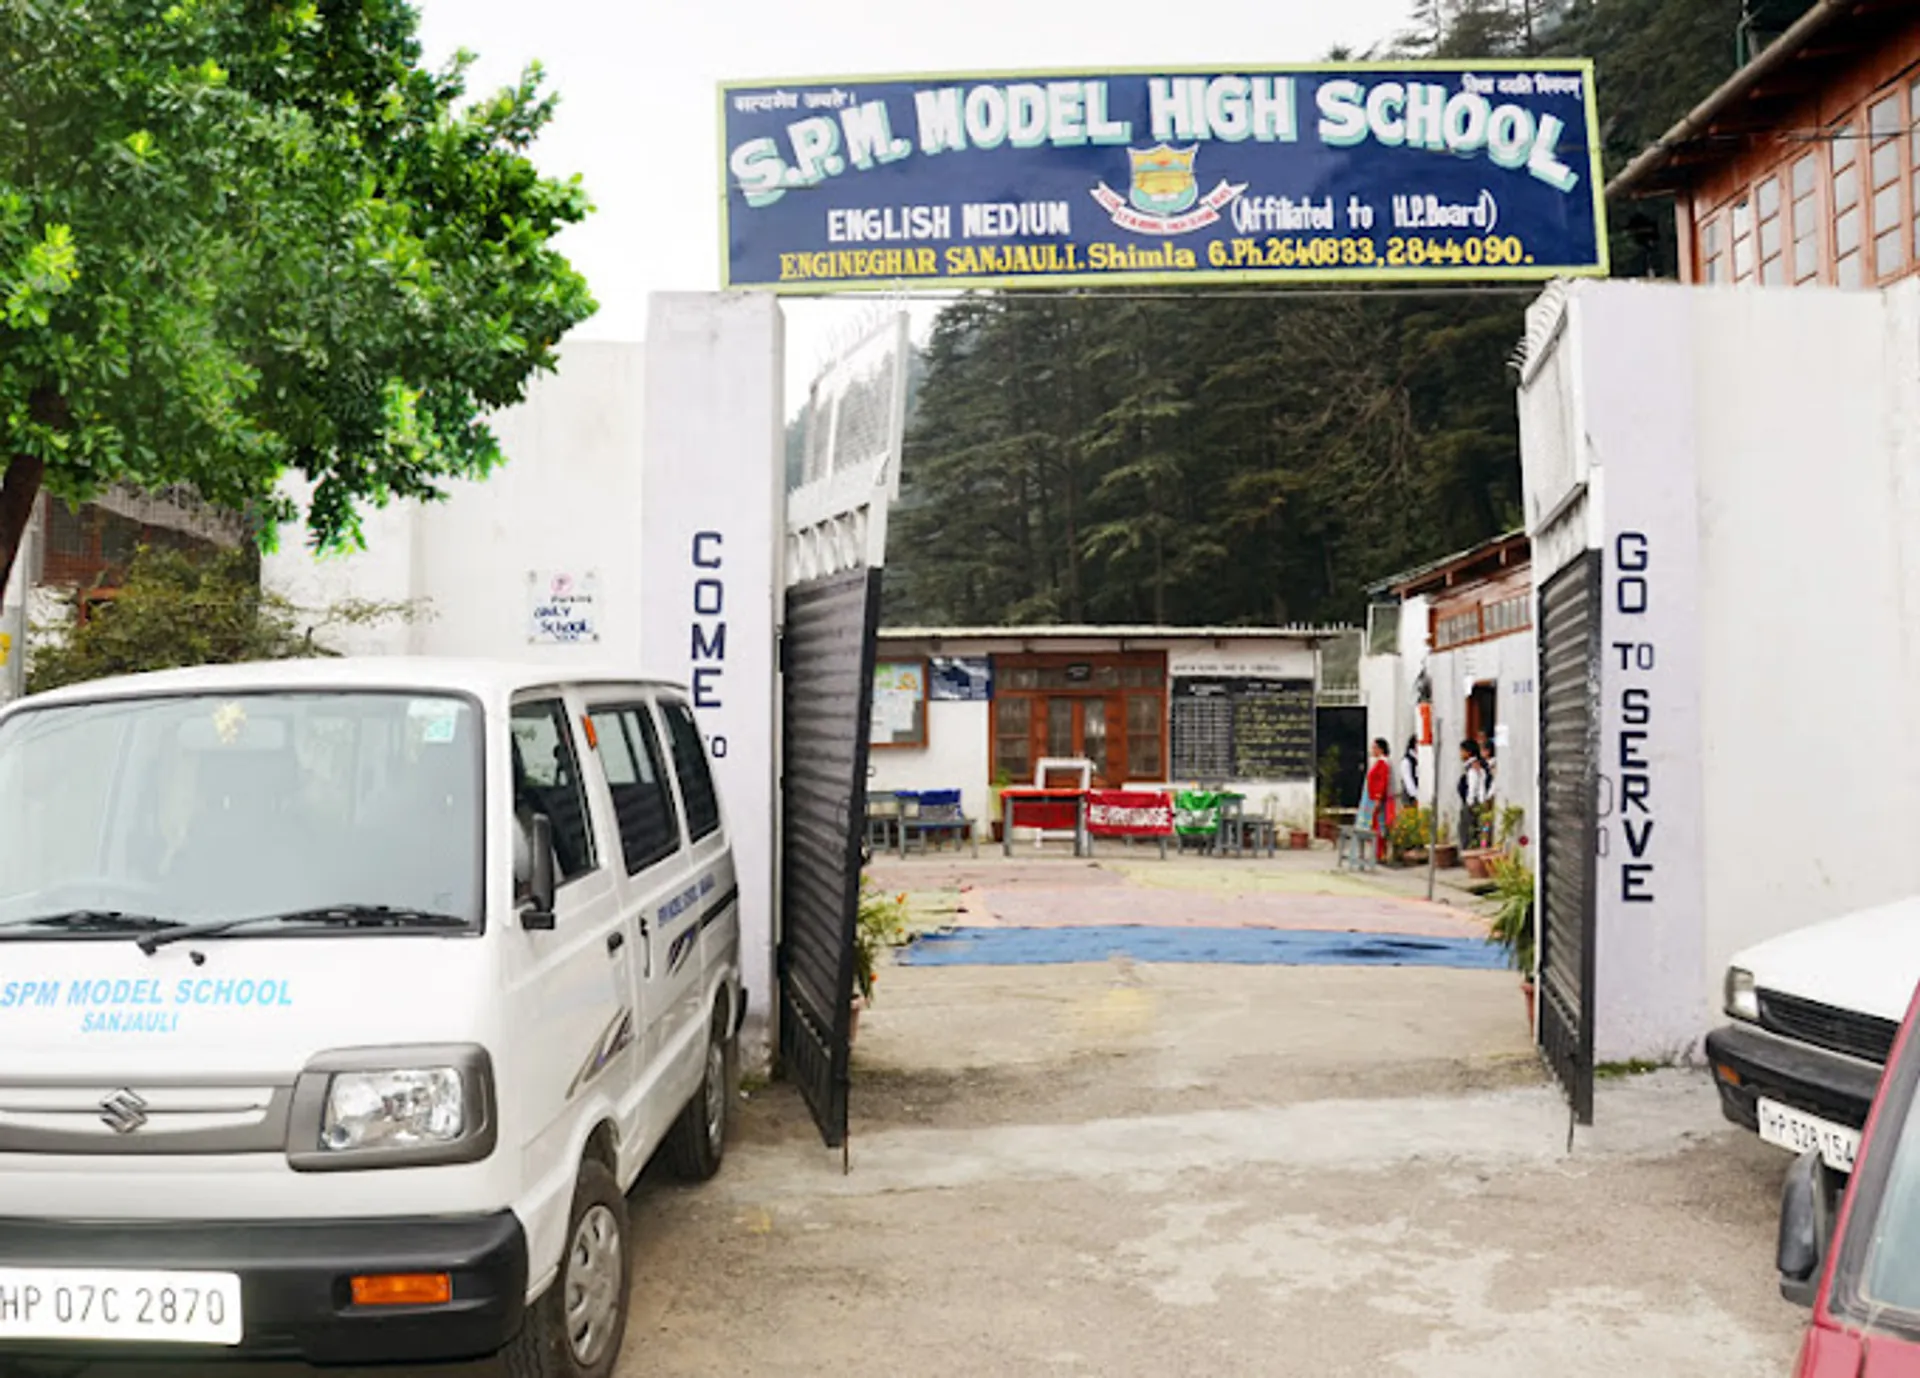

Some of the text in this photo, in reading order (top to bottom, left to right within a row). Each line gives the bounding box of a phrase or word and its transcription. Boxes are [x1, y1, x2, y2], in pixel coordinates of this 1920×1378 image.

[914, 80, 1132, 156] MODEL
[1149, 76, 1299, 143] HIGH
[1315, 80, 1580, 193] SCHOOL
[827, 206, 951, 243] ENGLISH
[961, 201, 1071, 240] MEDIUM
[1230, 195, 1334, 235] (Affiliated
[1347, 198, 1374, 229] to
[779, 248, 938, 281] ENGINEGHAR
[1087, 243, 1196, 270] Shimla
[691, 530, 727, 708] COME
[1612, 532, 1655, 902] GO TO SERVE
[0, 978, 294, 1008] SPM MODEL SCHOOL
[80, 1010, 181, 1034] SANJAULI
[0, 1284, 226, 1326] HP 07C 2870
